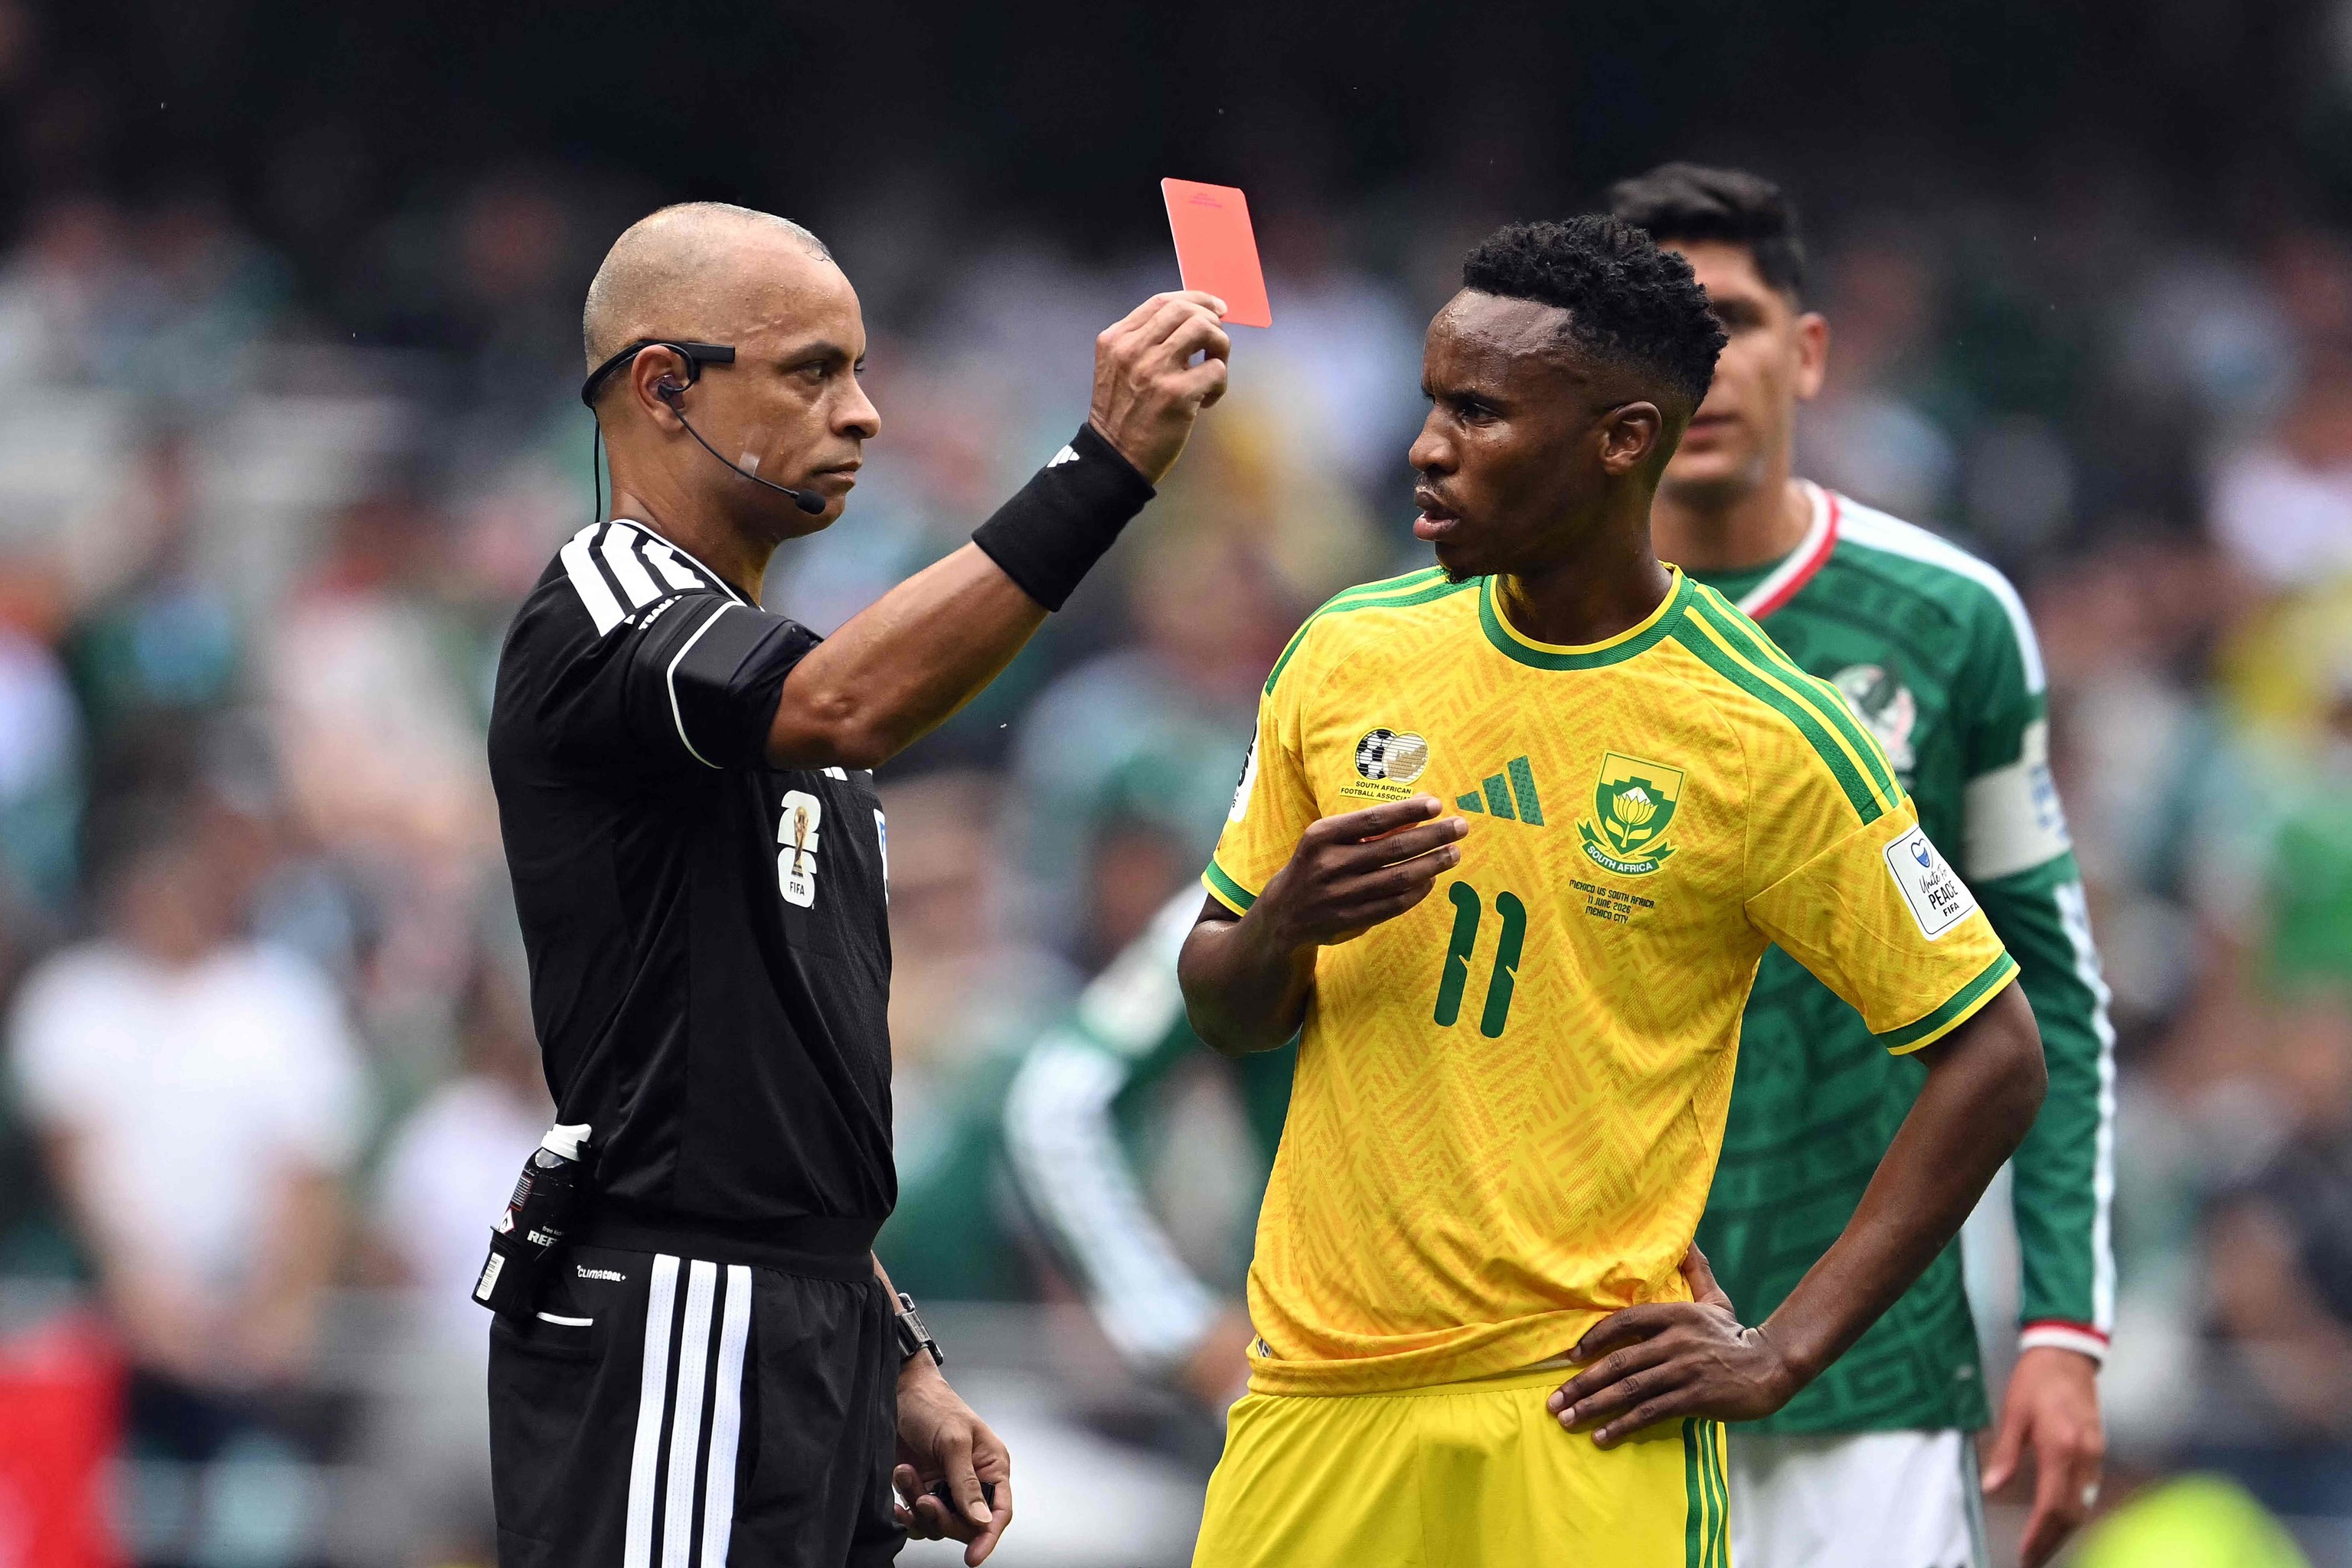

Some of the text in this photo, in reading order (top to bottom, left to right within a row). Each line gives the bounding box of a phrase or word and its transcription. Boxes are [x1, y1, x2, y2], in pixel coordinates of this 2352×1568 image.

[1341, 787, 1410, 801] FOOTBALL ASSOCIA
[1356, 781, 1412, 794] SOUTH AFRICAN
[1587, 845, 1653, 873] SOUTH AFRICA
[789, 882, 805, 896] FIFA
[1569, 879, 1596, 893] MEXICO
[1607, 890, 1630, 902] SOUTH
[1630, 895, 1655, 909] AFRICA
[1929, 880, 1958, 910] PEACE
[1588, 894, 1632, 914] 11 JUNE 2026
[1942, 902, 1960, 917] FIFA
[1585, 906, 1628, 924] MEXICO CITY
[1433, 880, 1527, 1039] 11
[527, 1229, 557, 1247] REF
[577, 1267, 621, 1282] CLIMACOOL
